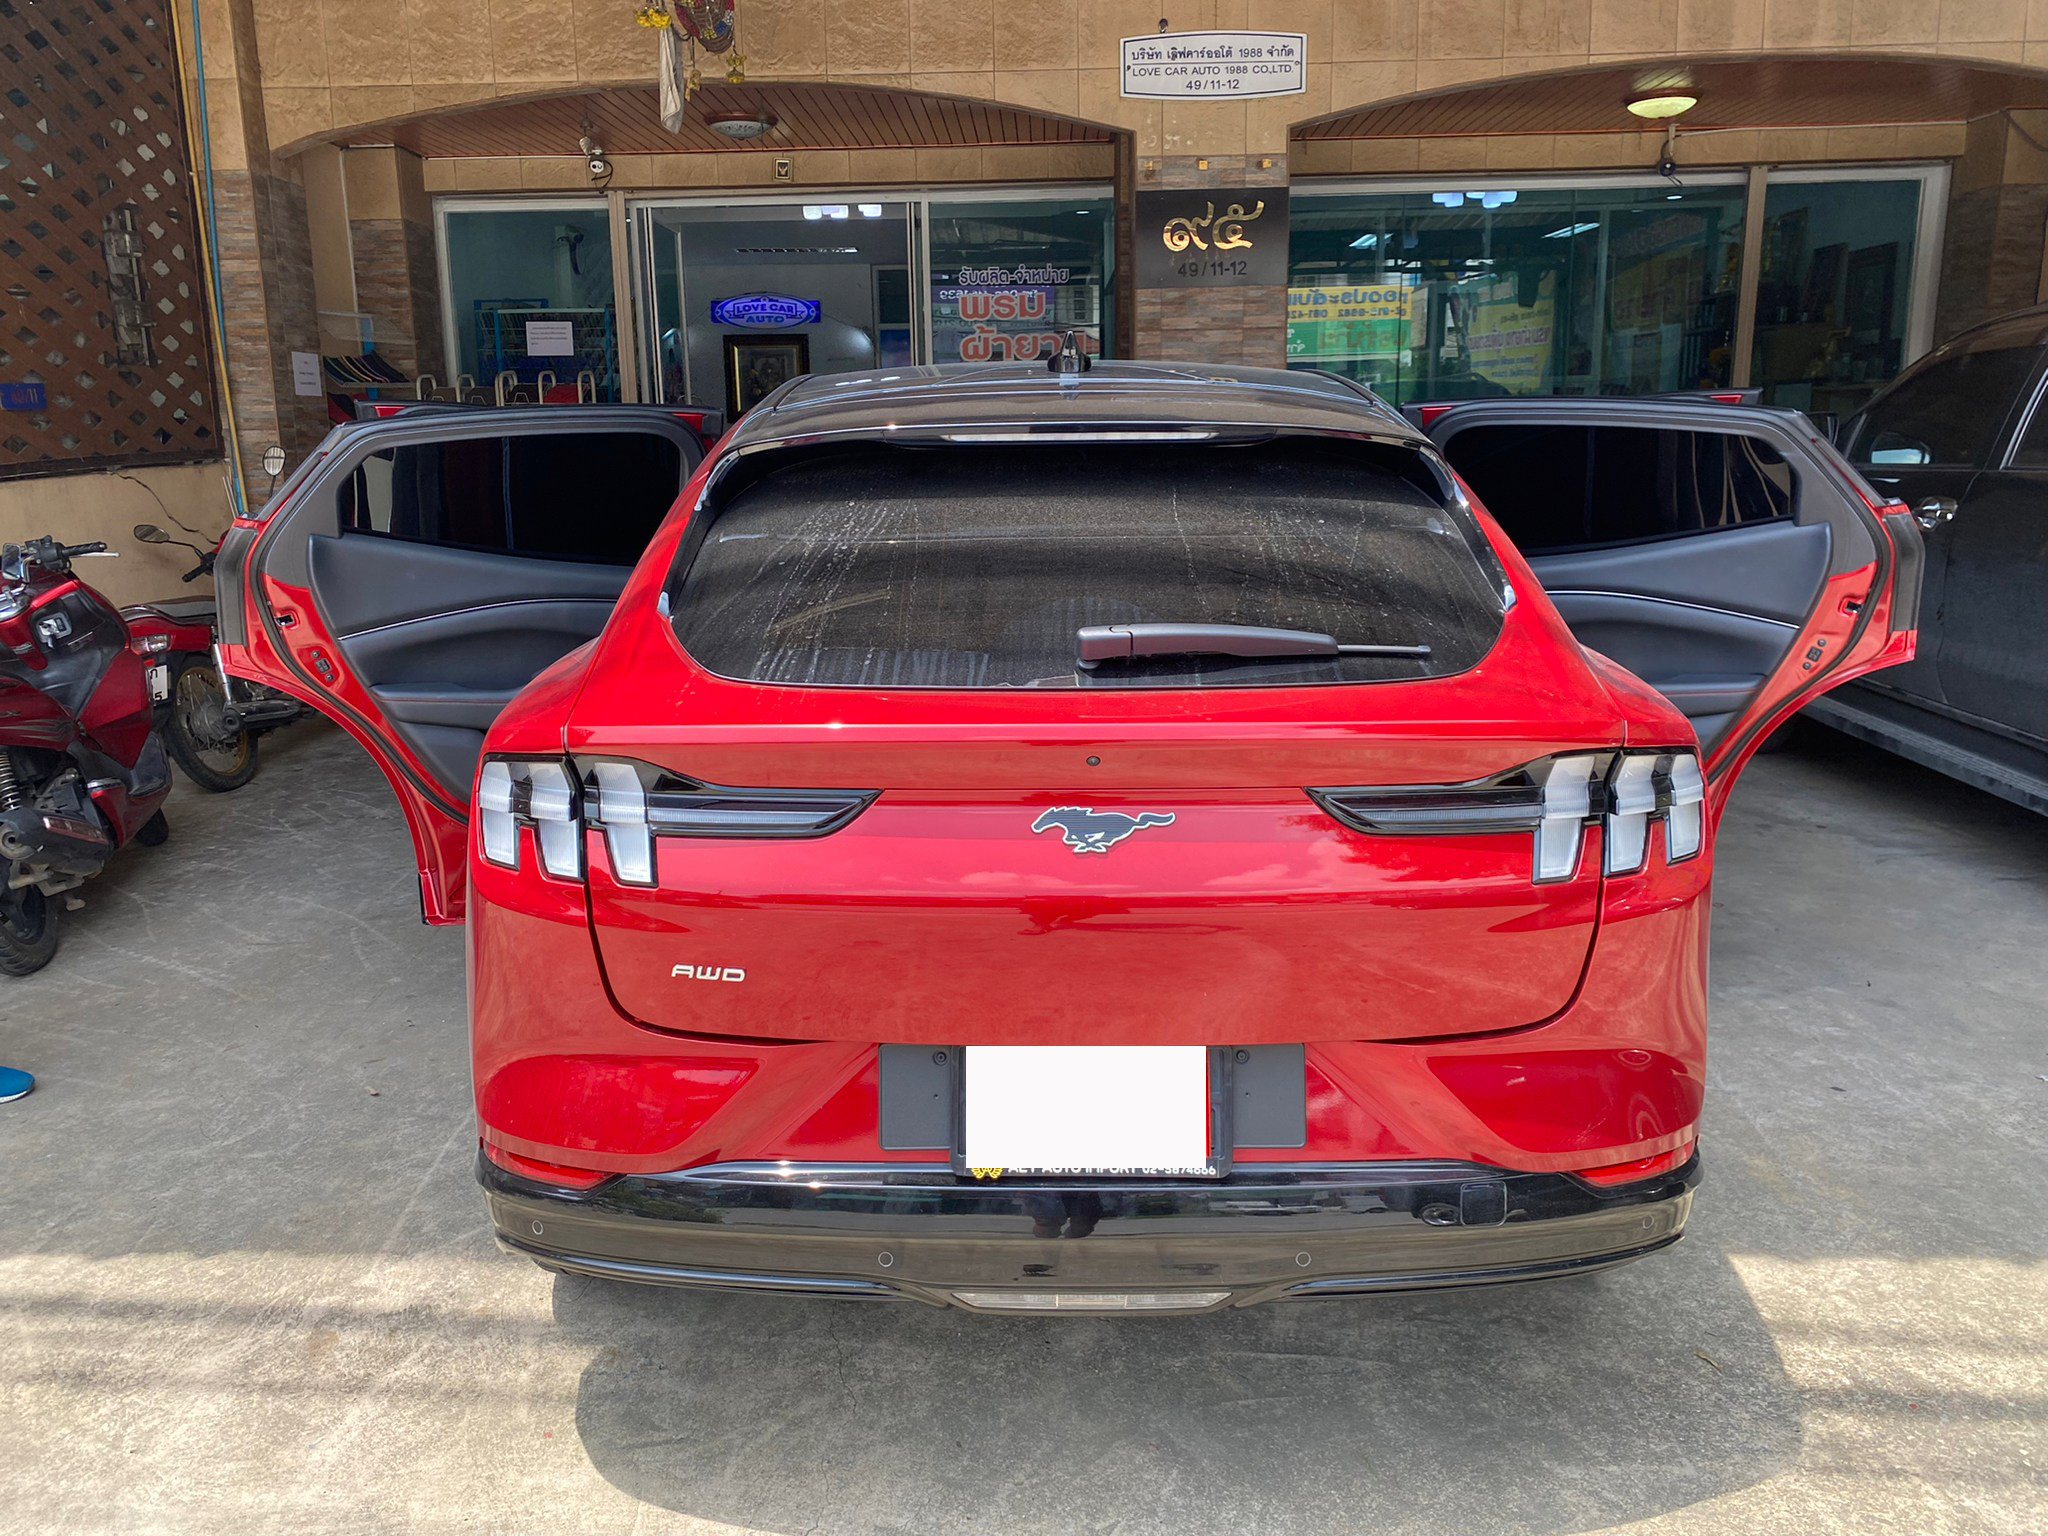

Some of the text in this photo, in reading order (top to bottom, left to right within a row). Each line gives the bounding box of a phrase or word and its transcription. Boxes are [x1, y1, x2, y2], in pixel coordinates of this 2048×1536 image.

[1132, 47, 1163, 61] บริษัท
[1239, 48, 1263, 58] 1988
[1266, 44, 1295, 57] จำกัด
[1132, 66, 1161, 77] LOVE
[1164, 65, 1188, 76] CAR
[1191, 65, 1220, 75] AUTO
[1225, 64, 1248, 74] 1988
[1185, 79, 1240, 90] 49/11-12
[958, 263, 1070, 286] รับผลิต-จำหน่าย
[1177, 260, 1247, 277] 49/11-12
[736, 303, 794, 314] LOVE CAR
[958, 292, 1046, 320] พรม
[671, 963, 746, 983] AWD
